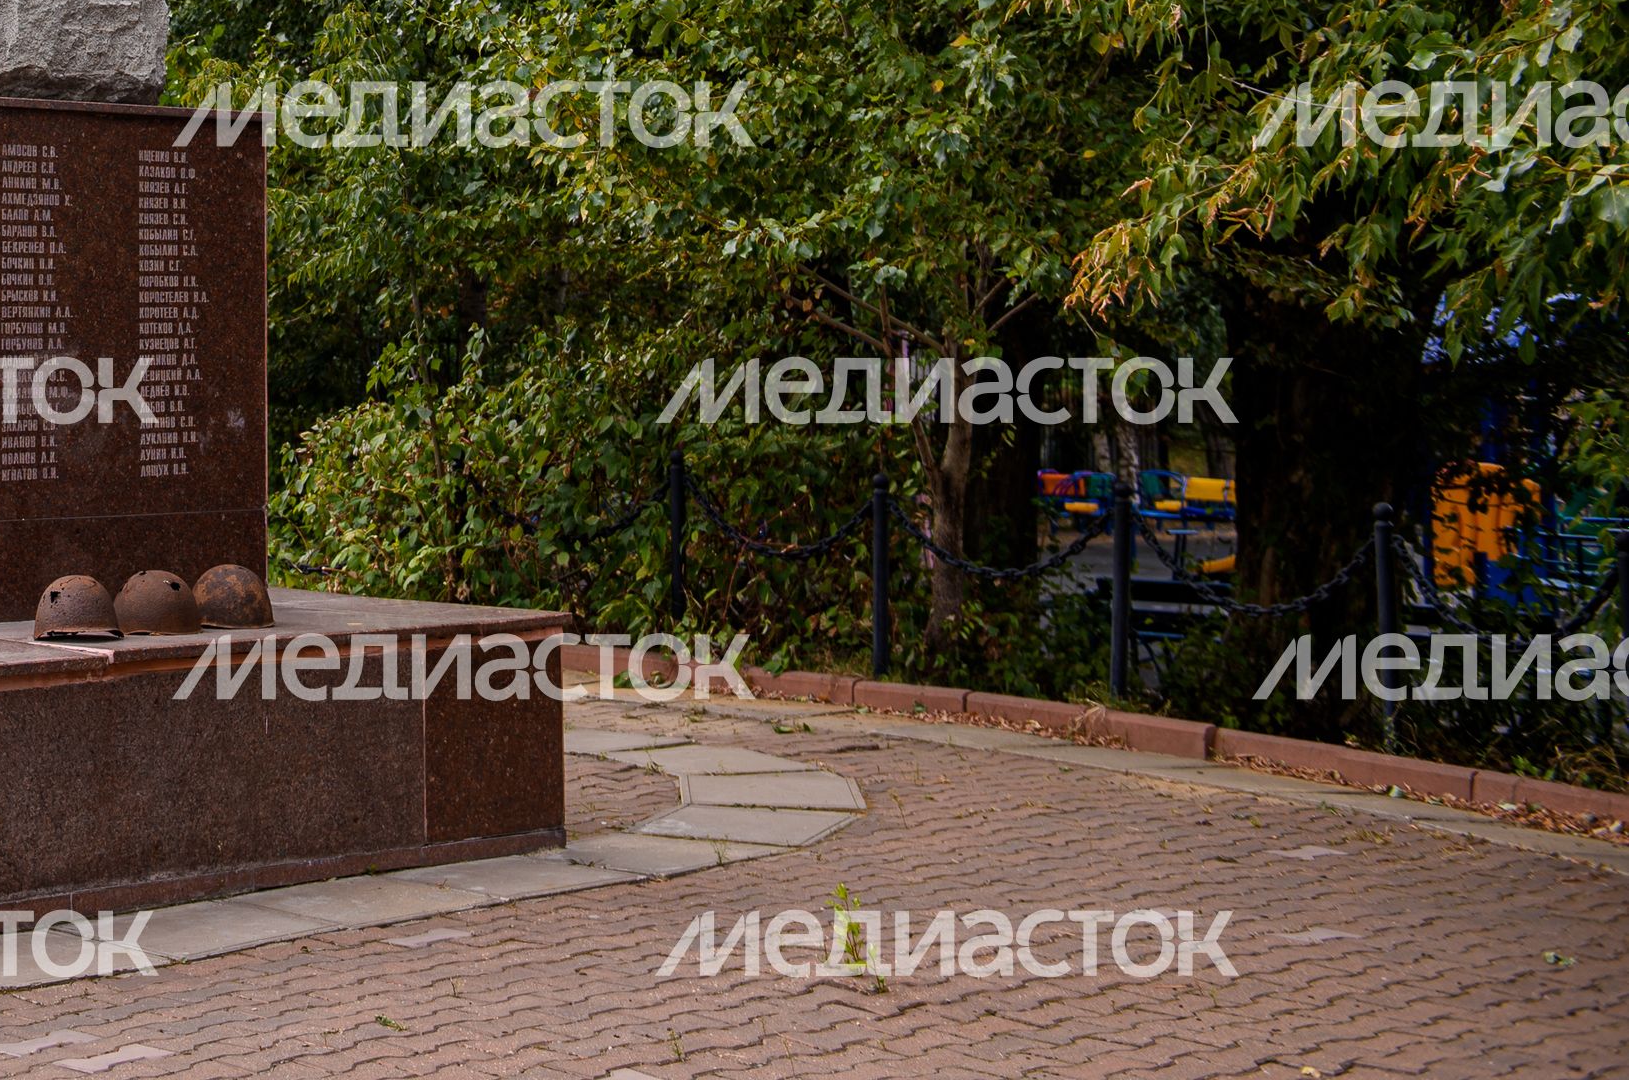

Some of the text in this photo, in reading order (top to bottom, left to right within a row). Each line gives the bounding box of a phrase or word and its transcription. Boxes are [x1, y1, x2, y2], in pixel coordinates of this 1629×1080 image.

[1, 160, 37, 173] АНДРЕЕВ
[139, 166, 176, 178] КАЗАКОВ
[139, 181, 169, 193] КНЯЗЕВ
[1, 193, 59, 206] АХМЕДЗЯНОВ
[139, 197, 168, 208] КНЯЗЕВ
[139, 212, 168, 224] КНЯЗЕВ
[1, 225, 37, 236] БАРАНОВ
[1, 258, 34, 269] БОЧКИН
[1, 274, 34, 285] БОЧКИН
[139, 291, 189, 303] КОРОСТЕЛЕВ
[1, 306, 50, 318] ВЕРТЯНКИН
[139, 306, 178, 318] КОРОТЕЕВ
[139, 338, 179, 351] КУЗНЕЦОВ
[1, 436, 36, 448] ИВАНОВ
